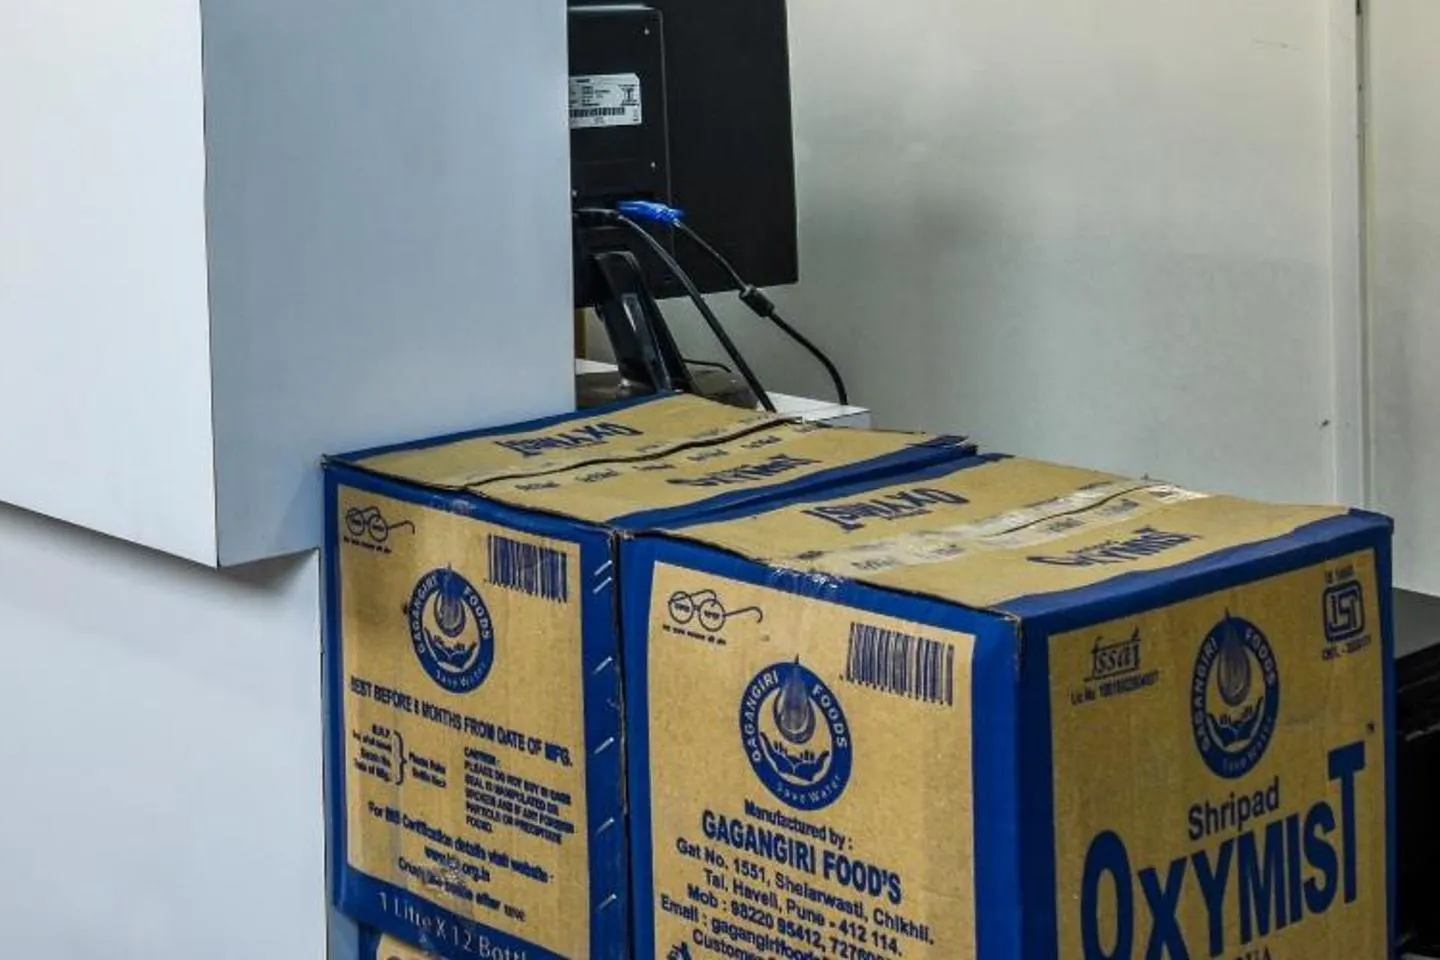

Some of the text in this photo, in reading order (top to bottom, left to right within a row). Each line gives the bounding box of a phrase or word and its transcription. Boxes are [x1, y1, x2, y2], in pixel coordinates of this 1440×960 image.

[374, 683, 413, 715] BEFORE
[421, 700, 462, 731] MONTHS
[464, 715, 497, 742] FROM
[497, 725, 526, 752] DATE
[526, 736, 543, 755] OF
[811, 684, 848, 749] FOODS
[744, 798, 827, 841] Manufactured
[829, 826, 846, 851] by
[1188, 775, 1280, 840] Shripad
[676, 836, 701, 860] Gat
[704, 846, 729, 871] No.
[702, 809, 902, 906] GAGANGIRI FOOD'S
[1081, 740, 1366, 960] OXYMIST
[661, 892, 700, 923] Email
[687, 883, 719, 909] Mob
[703, 867, 729, 893] Tal.
[786, 898, 825, 928] Pune
[839, 918, 867, 943] 412
